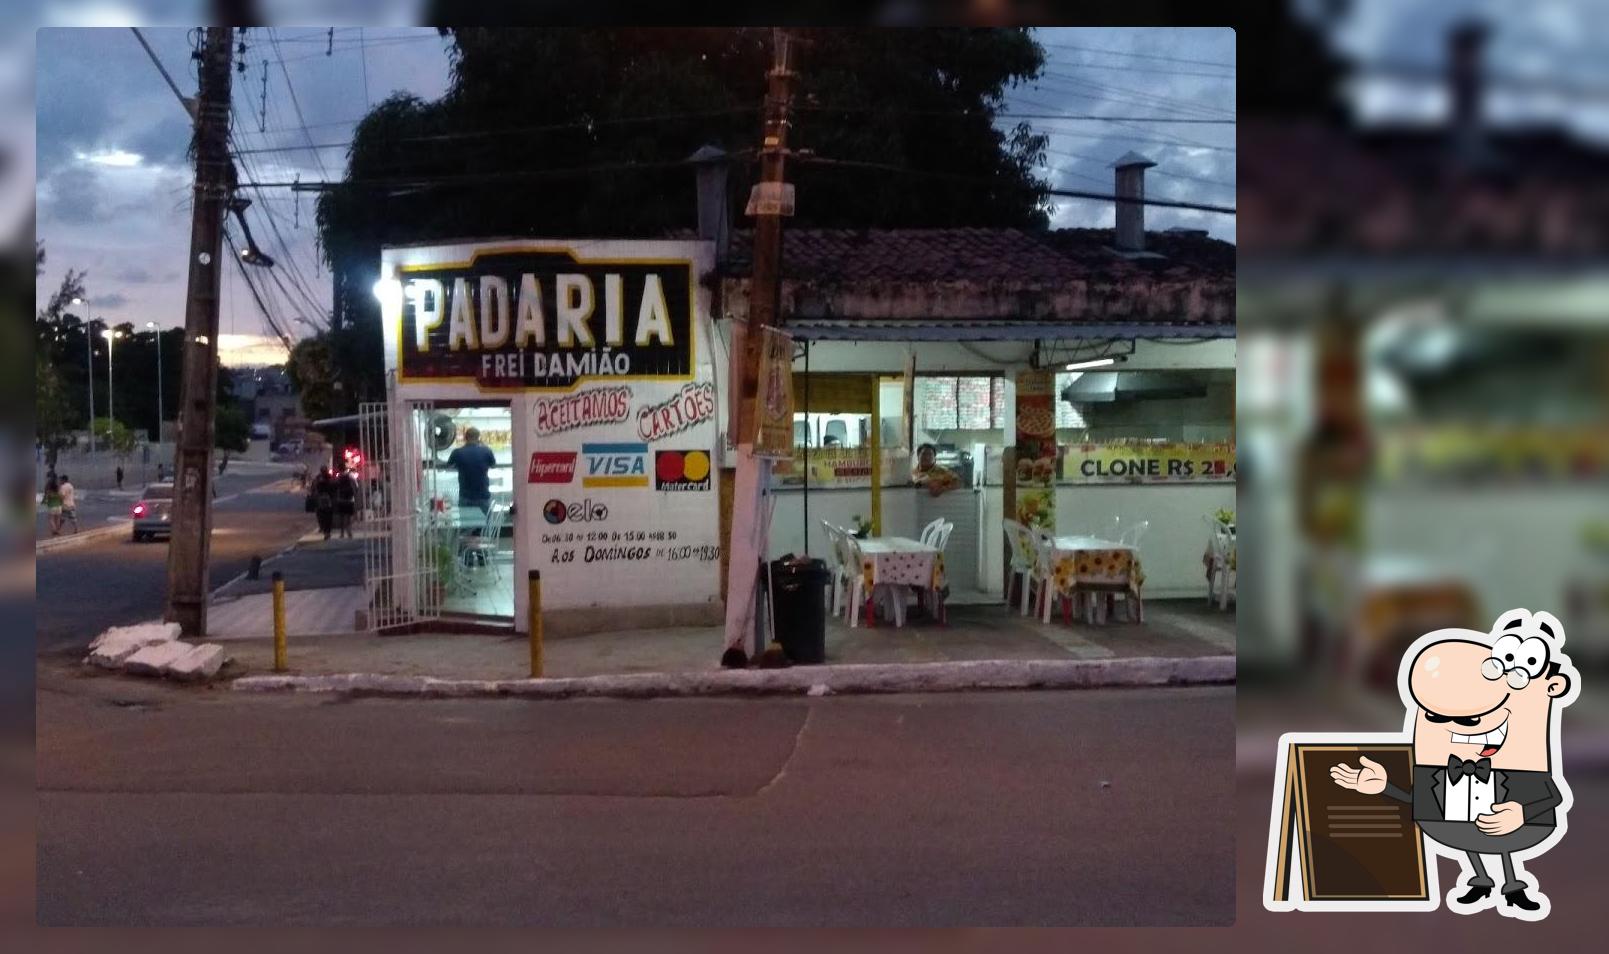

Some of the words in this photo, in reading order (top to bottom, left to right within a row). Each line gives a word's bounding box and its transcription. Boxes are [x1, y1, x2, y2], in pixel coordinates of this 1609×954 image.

[405, 273, 674, 351] PADARIA
[481, 348, 525, 377] FREI
[534, 346, 630, 378] DAMIÃO
[536, 389, 630, 432] ACEITAMOS
[638, 383, 714, 440] CARTÕES
[530, 457, 576, 478] Hipercard
[587, 455, 645, 475] VISA
[1080, 458, 1160, 477] CLONE
[1167, 458, 1194, 477] R$
[566, 498, 609, 523] elo
[584, 543, 652, 563] DOMINGOS
